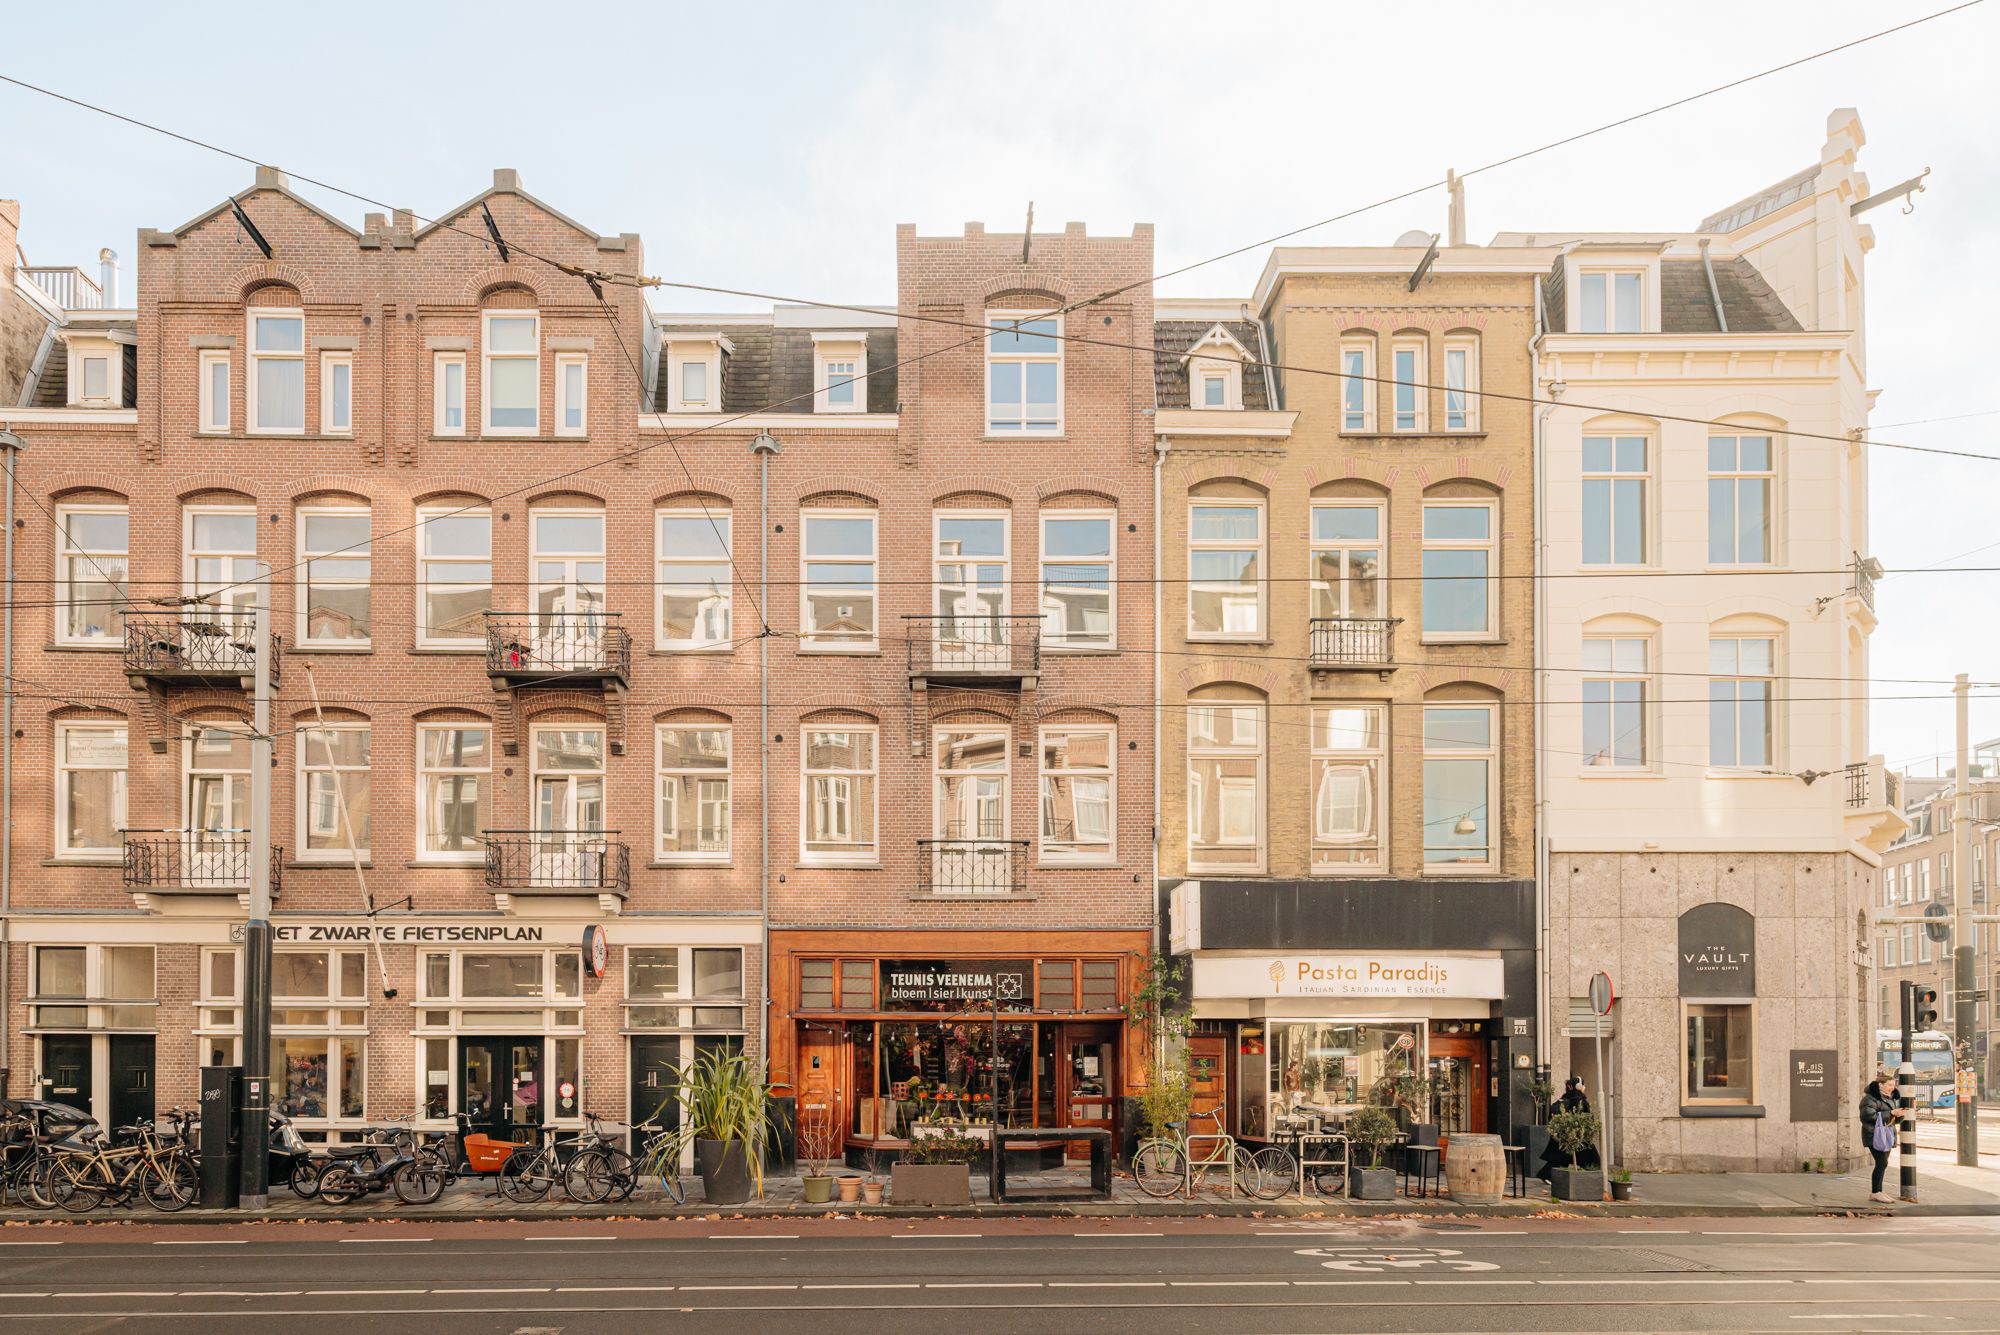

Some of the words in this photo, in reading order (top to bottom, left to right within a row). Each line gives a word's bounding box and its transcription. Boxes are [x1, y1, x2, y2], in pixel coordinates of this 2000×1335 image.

[272, 926, 302, 940] ET
[309, 926, 396, 940] ZWARTE
[403, 926, 543, 941] FIETSENPLAN
[1683, 953, 1750, 963] VAULT
[1298, 962, 1358, 980] Pasta
[1369, 961, 1448, 985] Paradijs
[890, 973, 934, 986] TEUNIS
[936, 973, 993, 986] VEENEMA
[891, 987, 926, 999] bloem
[933, 987, 954, 999] sier
[961, 987, 992, 999] kunst
[1407, 986, 1446, 994] ESSENCE
